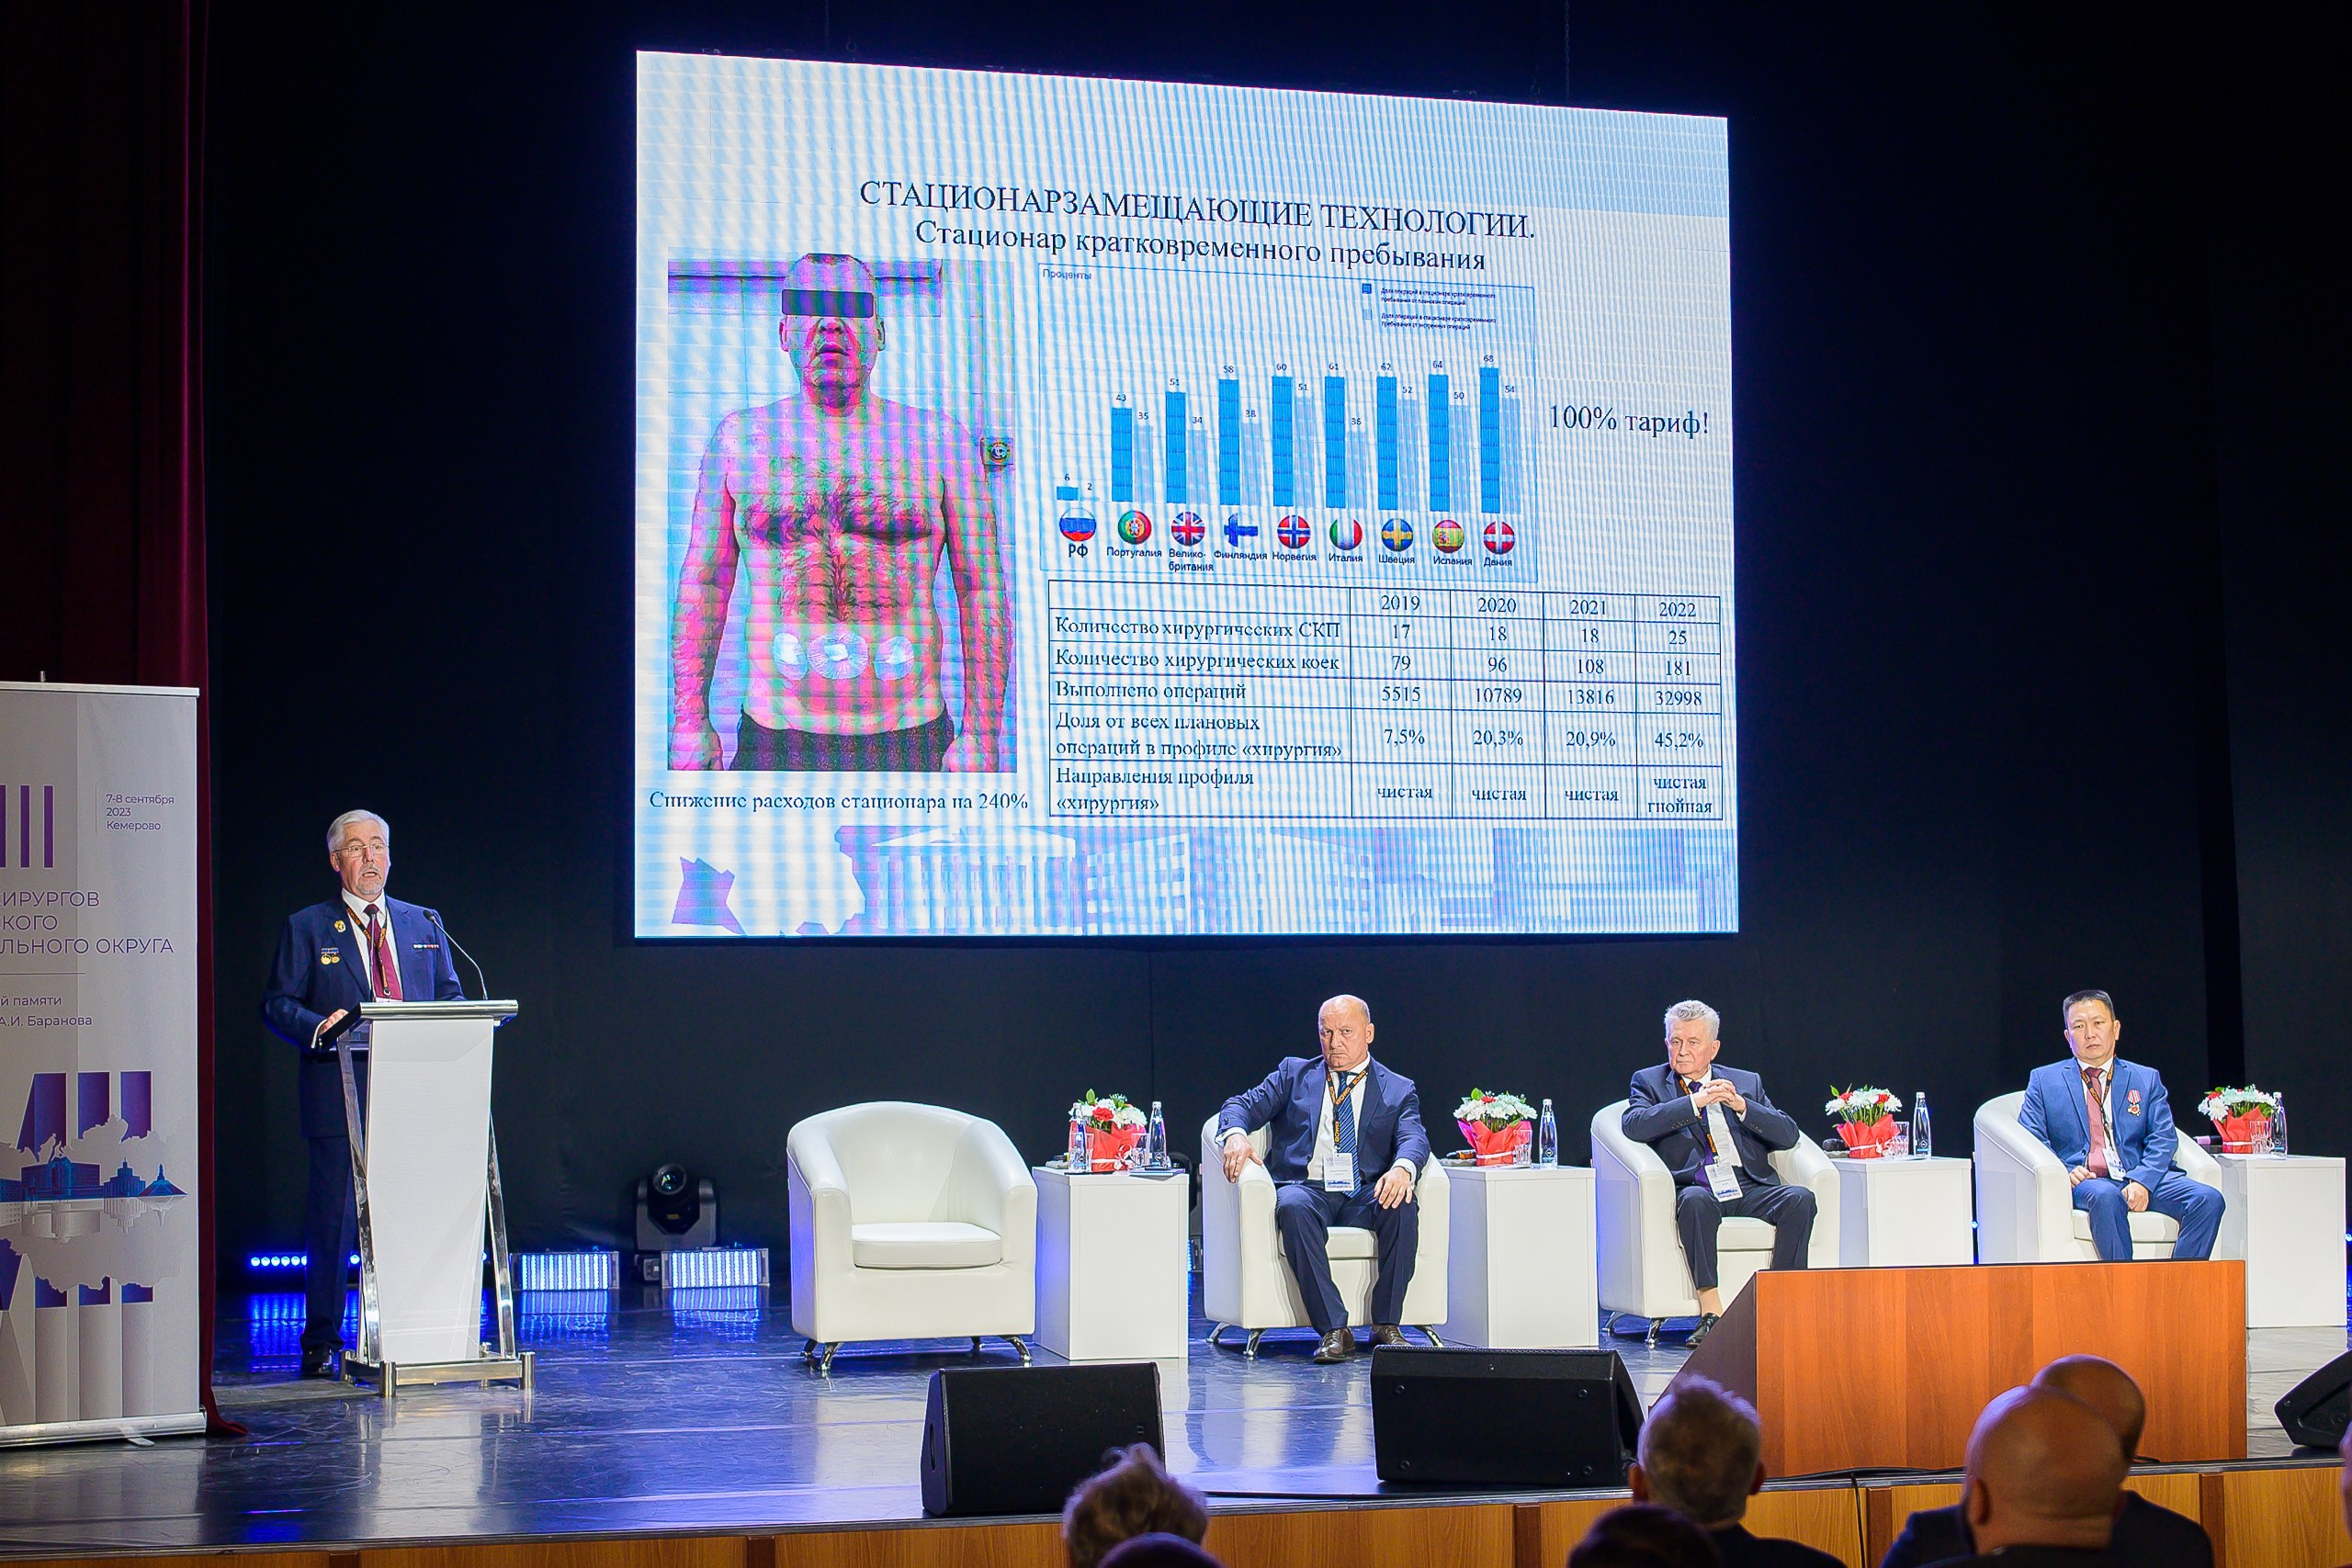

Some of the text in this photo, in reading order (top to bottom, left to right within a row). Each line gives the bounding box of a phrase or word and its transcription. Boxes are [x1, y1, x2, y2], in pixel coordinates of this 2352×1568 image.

[860, 181, 1535, 239] СТАЦИОНАРЗАМЕЩАЮЩИЕ ТЕХНОЛОГИИ.
[916, 220, 1486, 270] Стационар кратковременного пребывания
[1043, 268, 1092, 281] Проценты
[1432, 360, 1443, 369] 64
[1483, 355, 1495, 363] 68
[1223, 365, 1234, 374] 58
[1169, 378, 1181, 387] 51
[1297, 383, 1309, 391] 51
[1402, 386, 1413, 394] 52
[1504, 385, 1516, 394] 54
[1114, 393, 1126, 402] 43
[1453, 391, 1464, 400] 50
[1138, 412, 1149, 421] 35
[1192, 416, 1203, 425] 34
[1551, 404, 1709, 439] 100% тариф!
[1064, 473, 1071, 482] 6
[1087, 482, 1093, 491] 2
[1069, 544, 1089, 558] РФ
[1106, 547, 1162, 559] Португалия
[1169, 548, 1206, 558] Велико-
[1214, 550, 1268, 561] Финляндия
[1272, 552, 1317, 563] Норвегия
[1329, 553, 1363, 563] Италия
[1169, 561, 1215, 573] британия
[1378, 554, 1415, 565] Швеция
[1433, 556, 1473, 566] Испания
[1484, 558, 1513, 568] Дания
[1380, 594, 1421, 611] 2019
[1477, 597, 1517, 614] 2020
[1569, 599, 1607, 615] 2021
[1658, 603, 1698, 618] 2022
[1055, 616, 1341, 639] Количество хирургических СКП
[1392, 623, 1410, 640] 17
[1488, 626, 1508, 642] 18
[1581, 627, 1600, 644] 18
[1668, 629, 1688, 646] 25
[1055, 649, 1340, 672] Количество хирургических коек
[1391, 655, 1411, 671] 79
[1487, 657, 1508, 673] 96
[1577, 658, 1605, 675] 108
[1665, 660, 1692, 677] 181
[1055, 680, 1247, 702] Выполнено операций
[1381, 685, 1421, 703] 5515
[1475, 687, 1522, 705] 10789
[1567, 688, 1614, 705] 13816
[1654, 690, 1702, 707] 32998
[1055, 712, 1261, 731] Доля от всех плановых
[1383, 728, 1425, 747] 7,5%
[1473, 728, 1524, 748] 20,3%
[1566, 730, 1616, 749] 20,9%
[1654, 731, 1704, 750] 45,2%
[1056, 739, 1342, 761] операций в профиле «хирургия»
[1056, 768, 1254, 788] Направления профиля
[1653, 777, 1707, 791] чистая
[106, 793, 175, 806] 7-8 сентября
[1377, 786, 1433, 799] чистая
[1471, 788, 1527, 802] чистая
[1564, 789, 1620, 803] чистая
[650, 790, 1029, 814] Снижение расходов стационара на 240%
[1057, 797, 1159, 815] «хирургия»
[1647, 799, 1713, 815] гнойная
[106, 807, 131, 818] 2023
[106, 819, 162, 832] Кемерово
[0, 891, 100, 908] ИРУРГОВ
[96, 938, 175, 954] ОКРУГА
[13, 997, 62, 1007] памяти
[28, 1015, 93, 1029] Баранова
